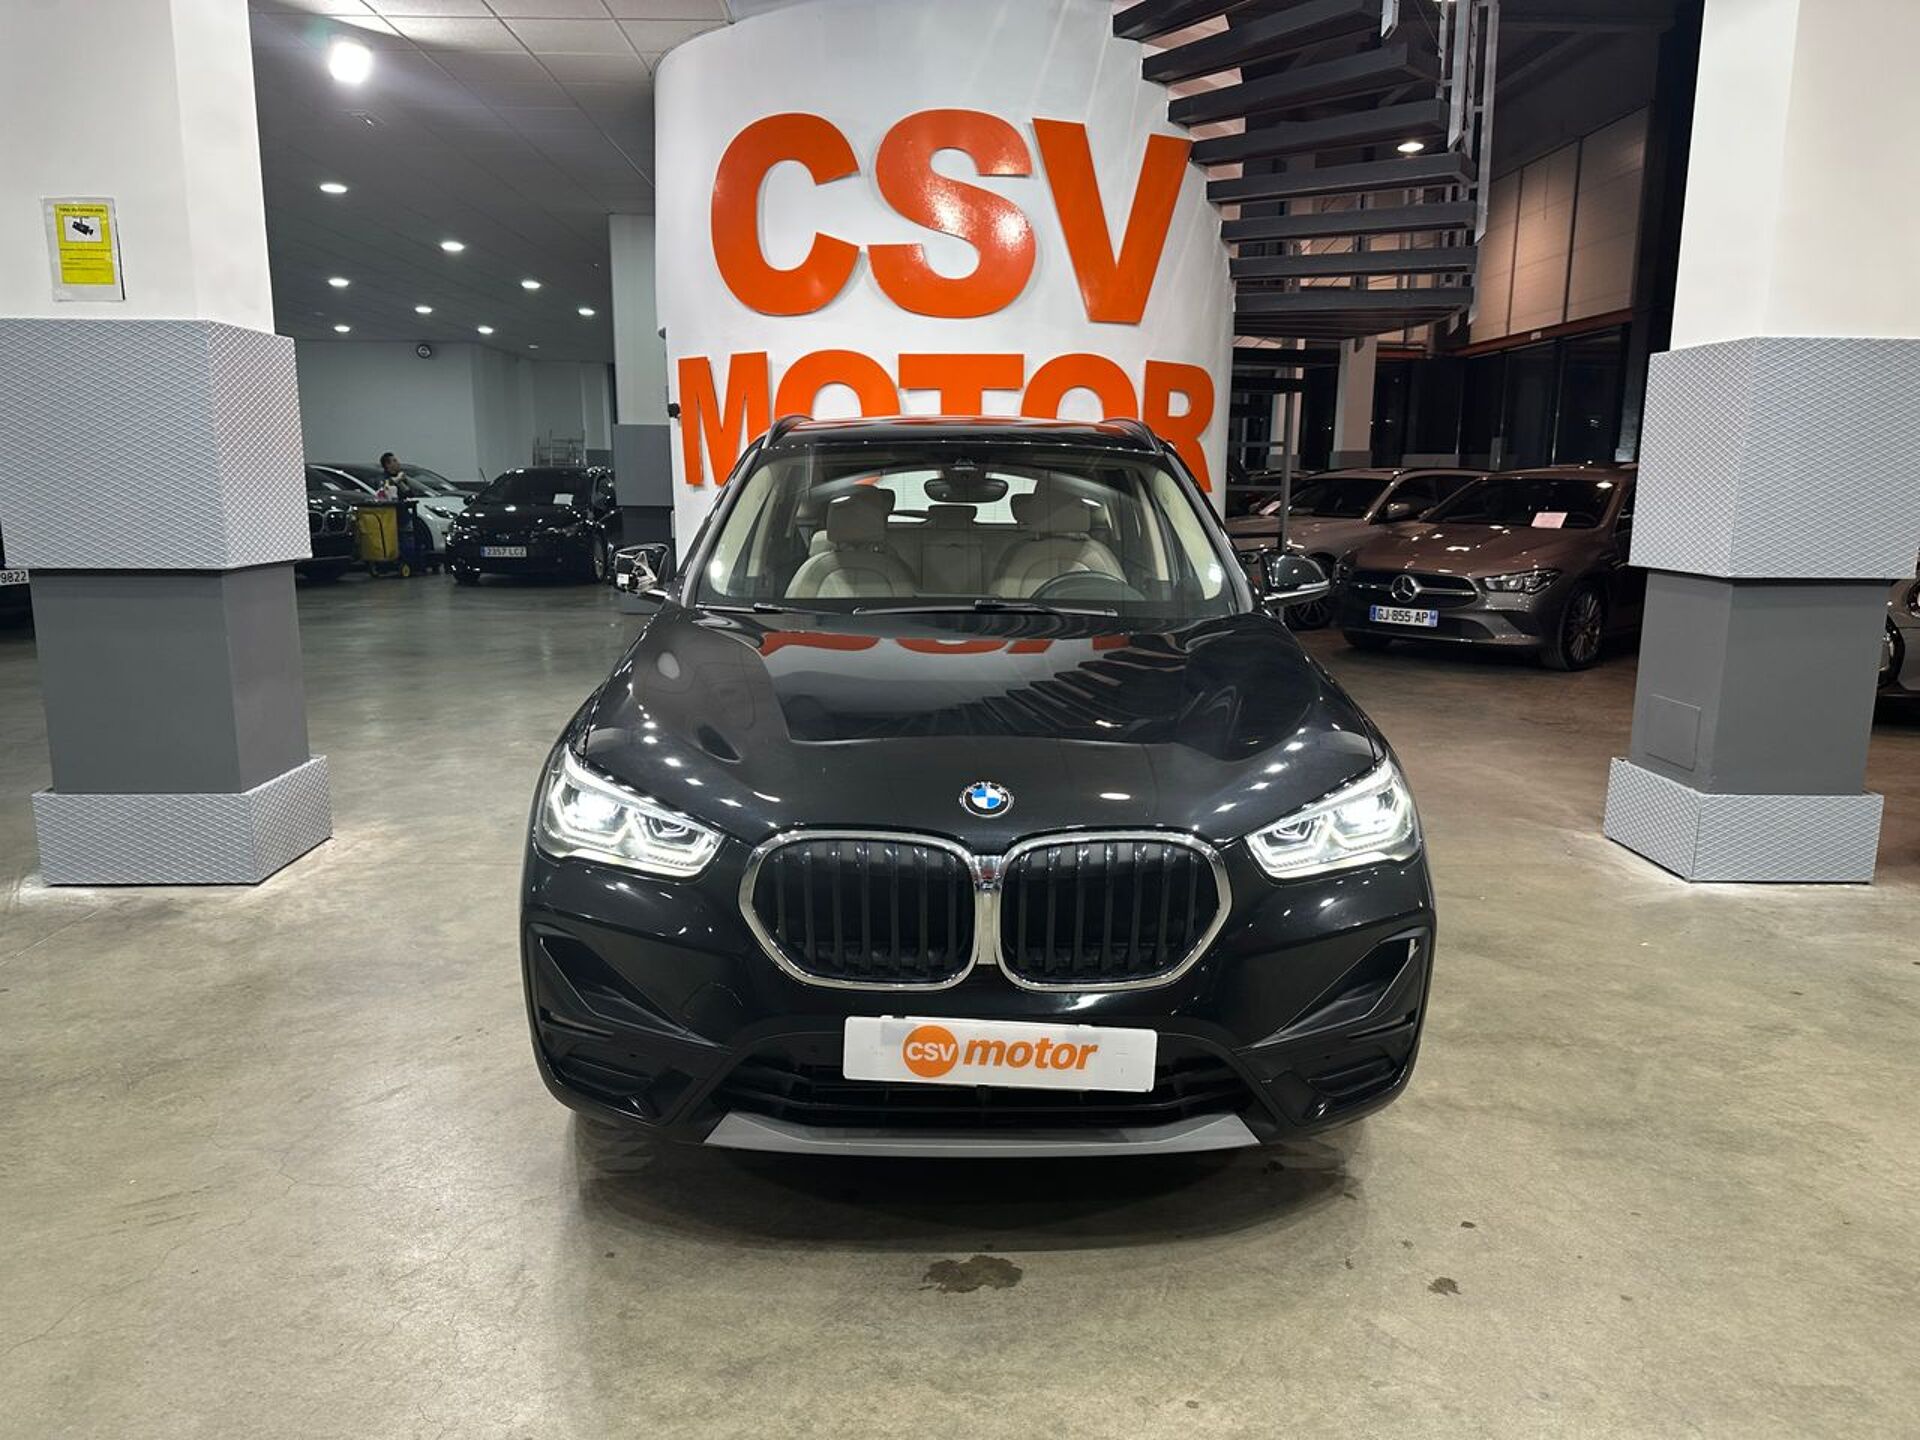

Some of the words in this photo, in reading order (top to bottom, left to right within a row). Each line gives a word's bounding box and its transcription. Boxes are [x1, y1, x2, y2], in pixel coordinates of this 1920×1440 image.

[711, 109, 1193, 325] CSV
[906, 1042, 957, 1062] CSV
[963, 1037, 1099, 1070] motor
